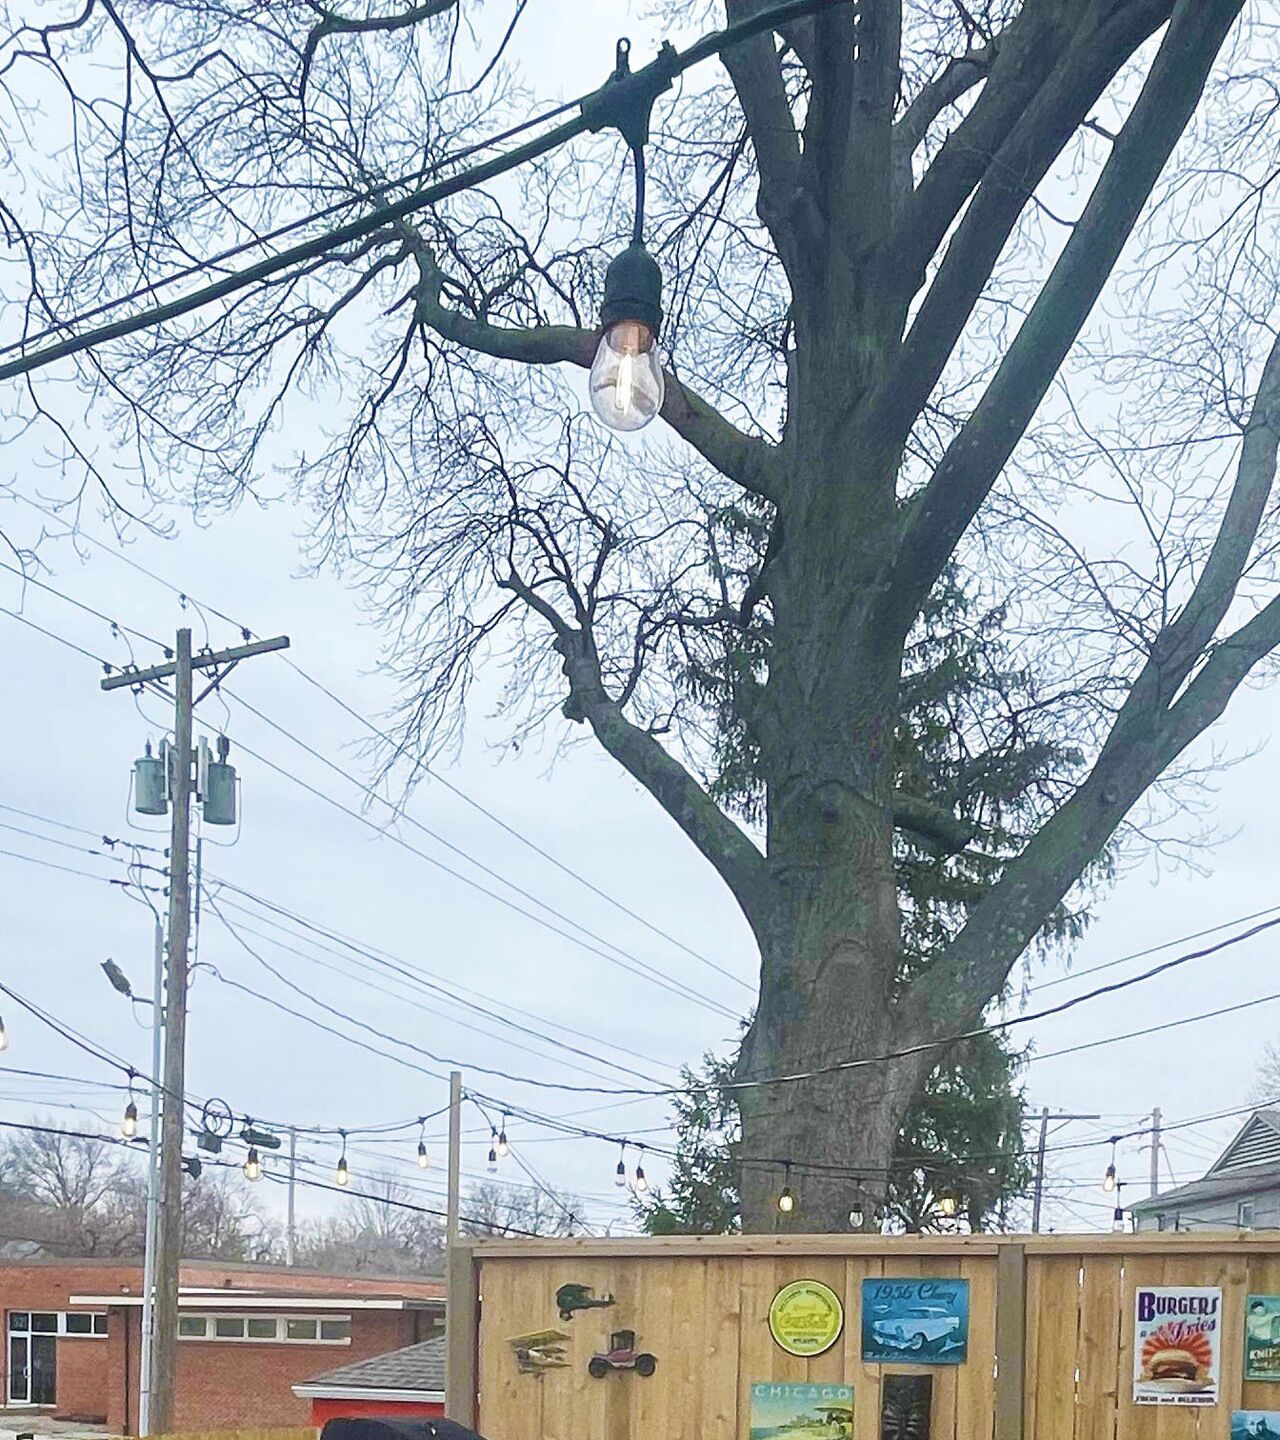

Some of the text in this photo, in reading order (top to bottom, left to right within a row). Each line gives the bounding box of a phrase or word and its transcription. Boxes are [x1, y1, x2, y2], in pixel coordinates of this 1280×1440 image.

[873, 1285, 914, 1301] 1956
[1138, 1292, 1220, 1322] BURGERS
[1167, 1316, 1217, 1344] Fries
[754, 1384, 850, 1400] CHICAGO
